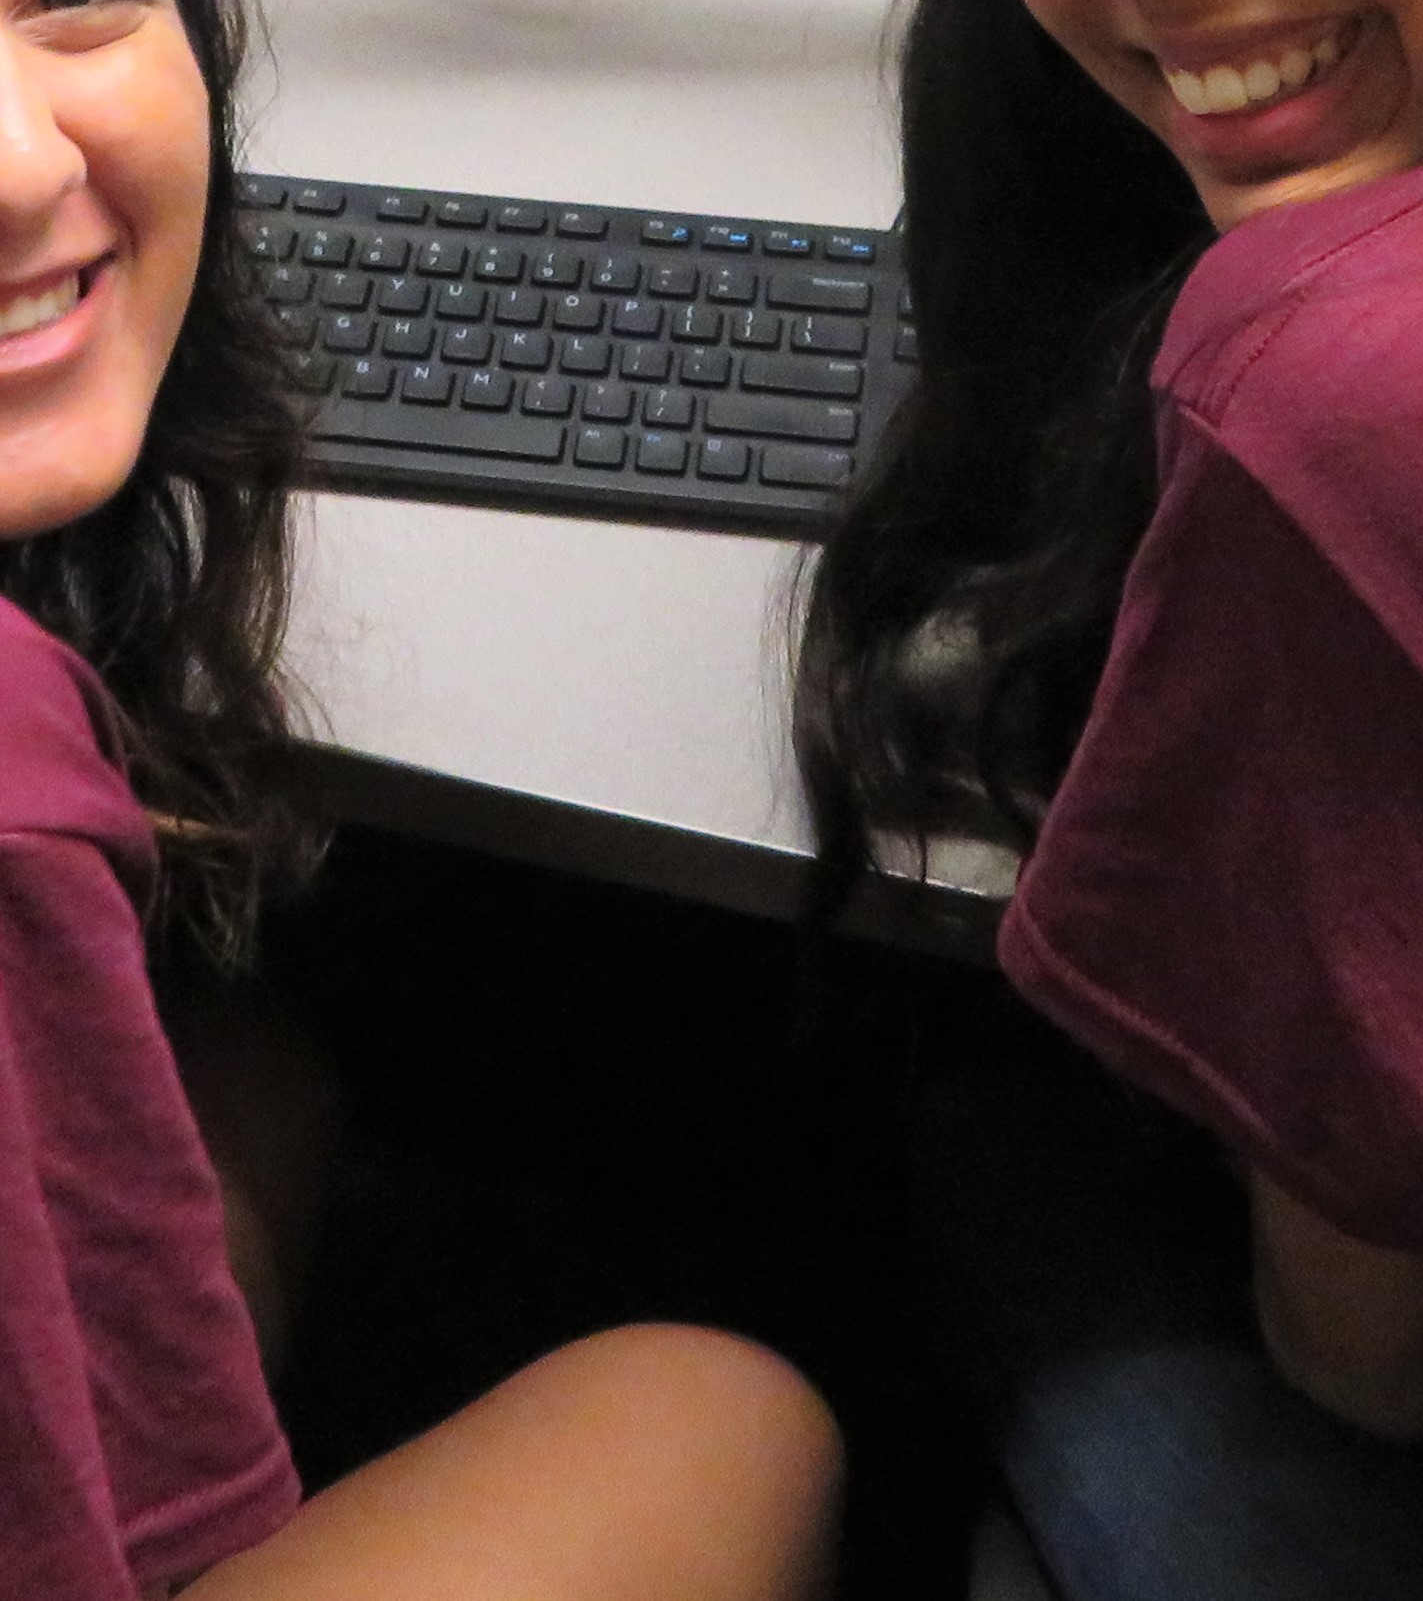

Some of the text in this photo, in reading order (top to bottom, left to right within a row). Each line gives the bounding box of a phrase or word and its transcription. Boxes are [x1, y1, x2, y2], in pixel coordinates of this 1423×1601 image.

[445, 283, 464, 298] U
[565, 293, 581, 309] O
[623, 299, 640, 314] P
[335, 312, 352, 329] G
[392, 320, 412, 336] H
[512, 331, 529, 347] K
[355, 359, 372, 375] B
[412, 364, 432, 381] N
[471, 370, 492, 388] M
